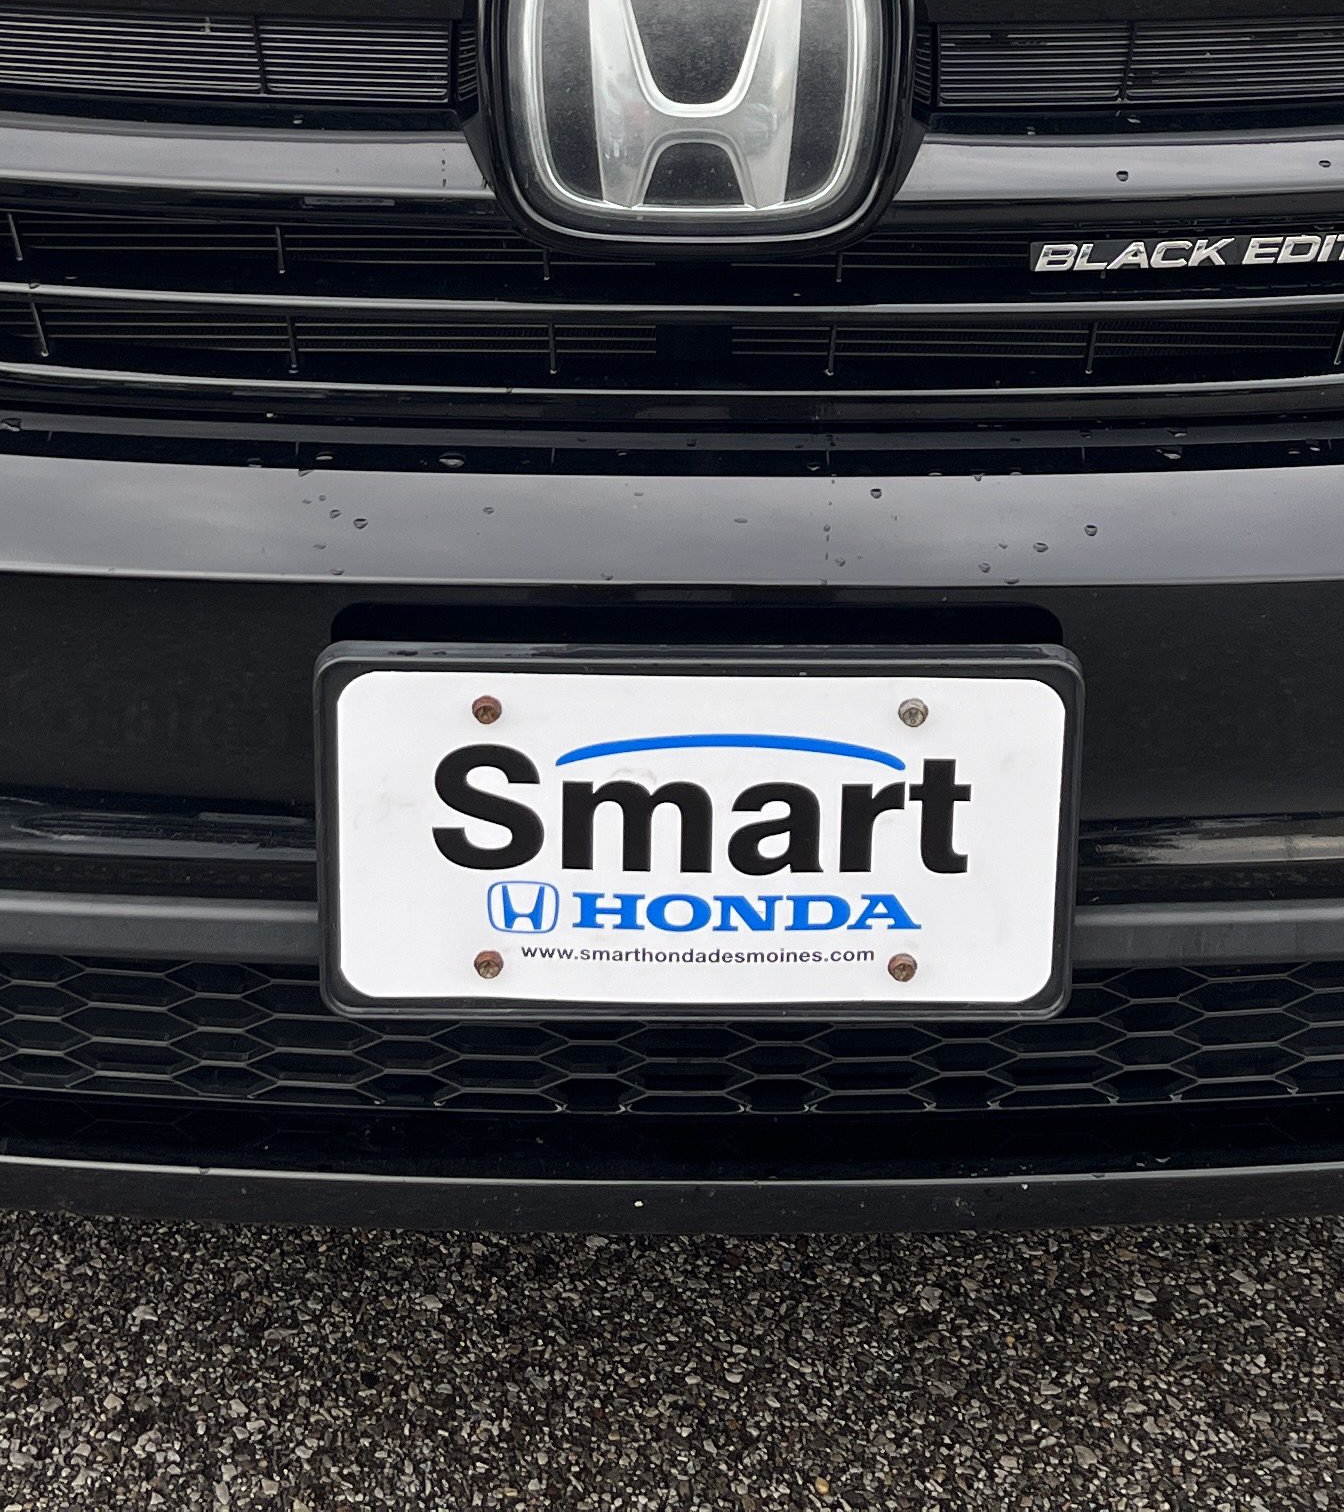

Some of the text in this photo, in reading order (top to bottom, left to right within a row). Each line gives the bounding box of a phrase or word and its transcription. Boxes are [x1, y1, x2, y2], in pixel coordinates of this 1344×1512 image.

[1034, 237, 1235, 272] BLACK
[431, 743, 972, 876] Smart
[572, 891, 922, 933] HONDA
[521, 945, 876, 964] www.smarthondadesmoines.com
